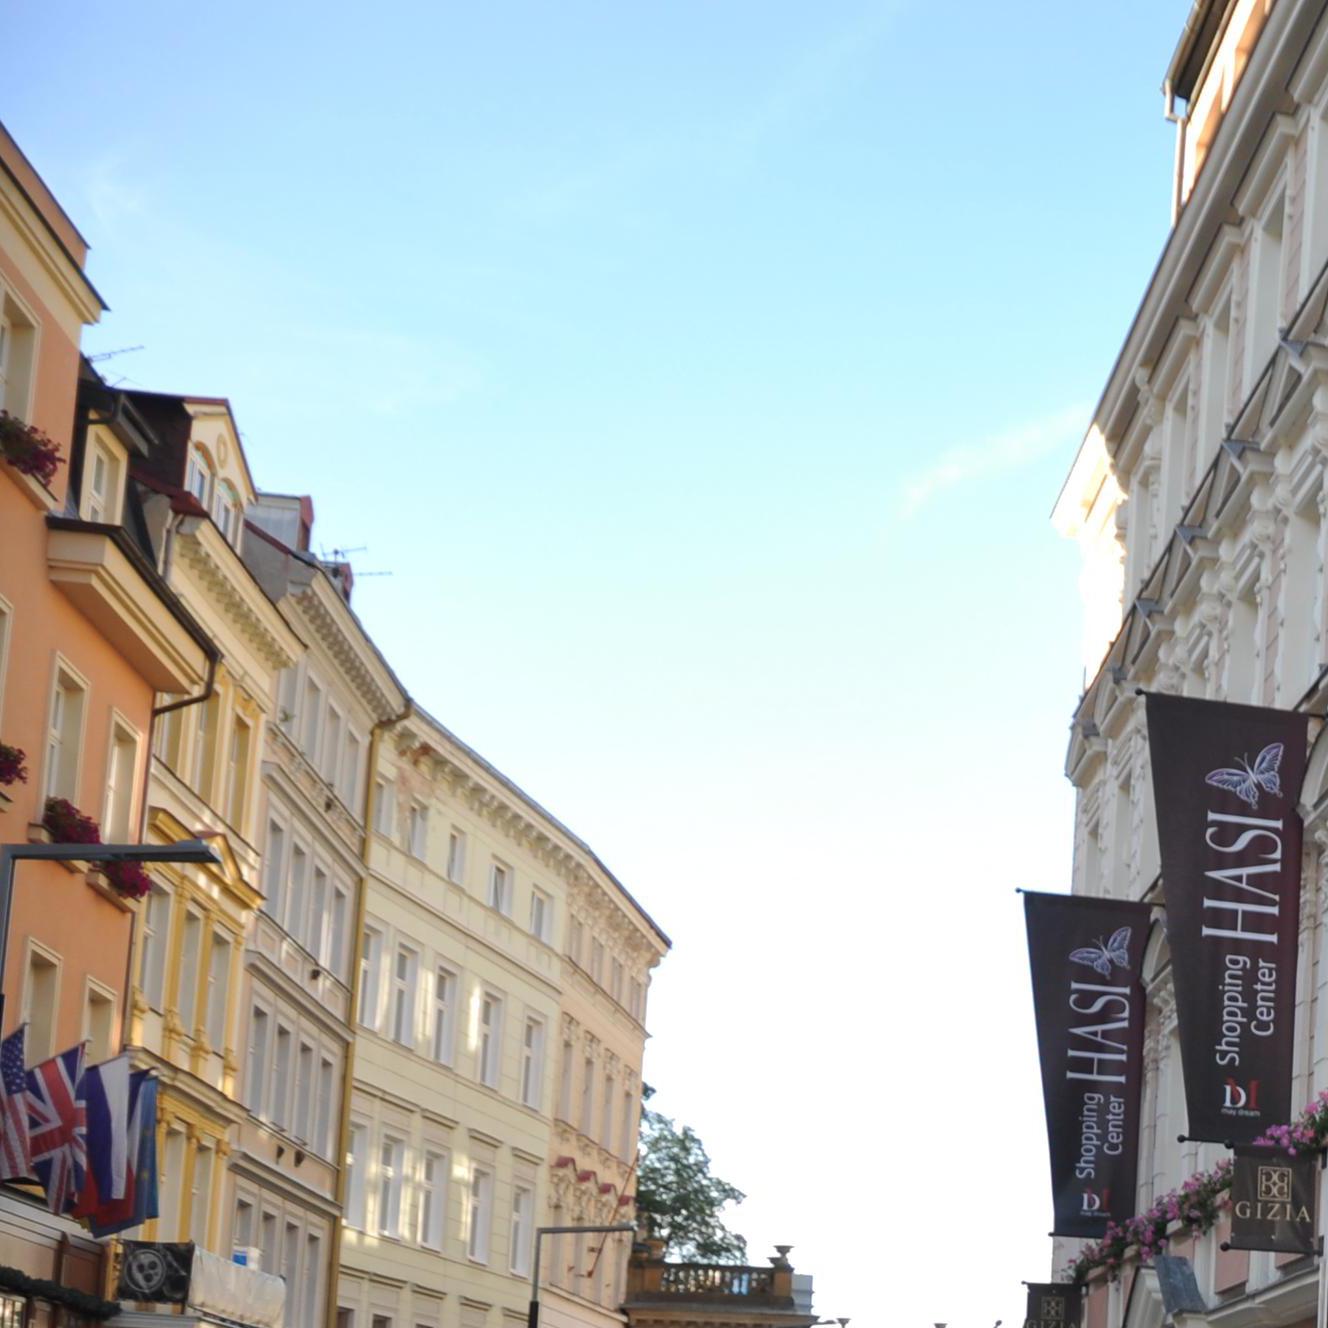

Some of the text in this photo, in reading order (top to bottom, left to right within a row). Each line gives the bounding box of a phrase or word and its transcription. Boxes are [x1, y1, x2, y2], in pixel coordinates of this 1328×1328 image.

[1201, 808, 1284, 944] HASI
[1066, 980, 1131, 1084] HASI
[1215, 954, 1251, 1067] Shopping
[1250, 957, 1277, 1037] Center
[1075, 1092, 1104, 1179] Shopping
[1103, 1095, 1125, 1156] Center
[1235, 1200, 1312, 1223] GIZIA
